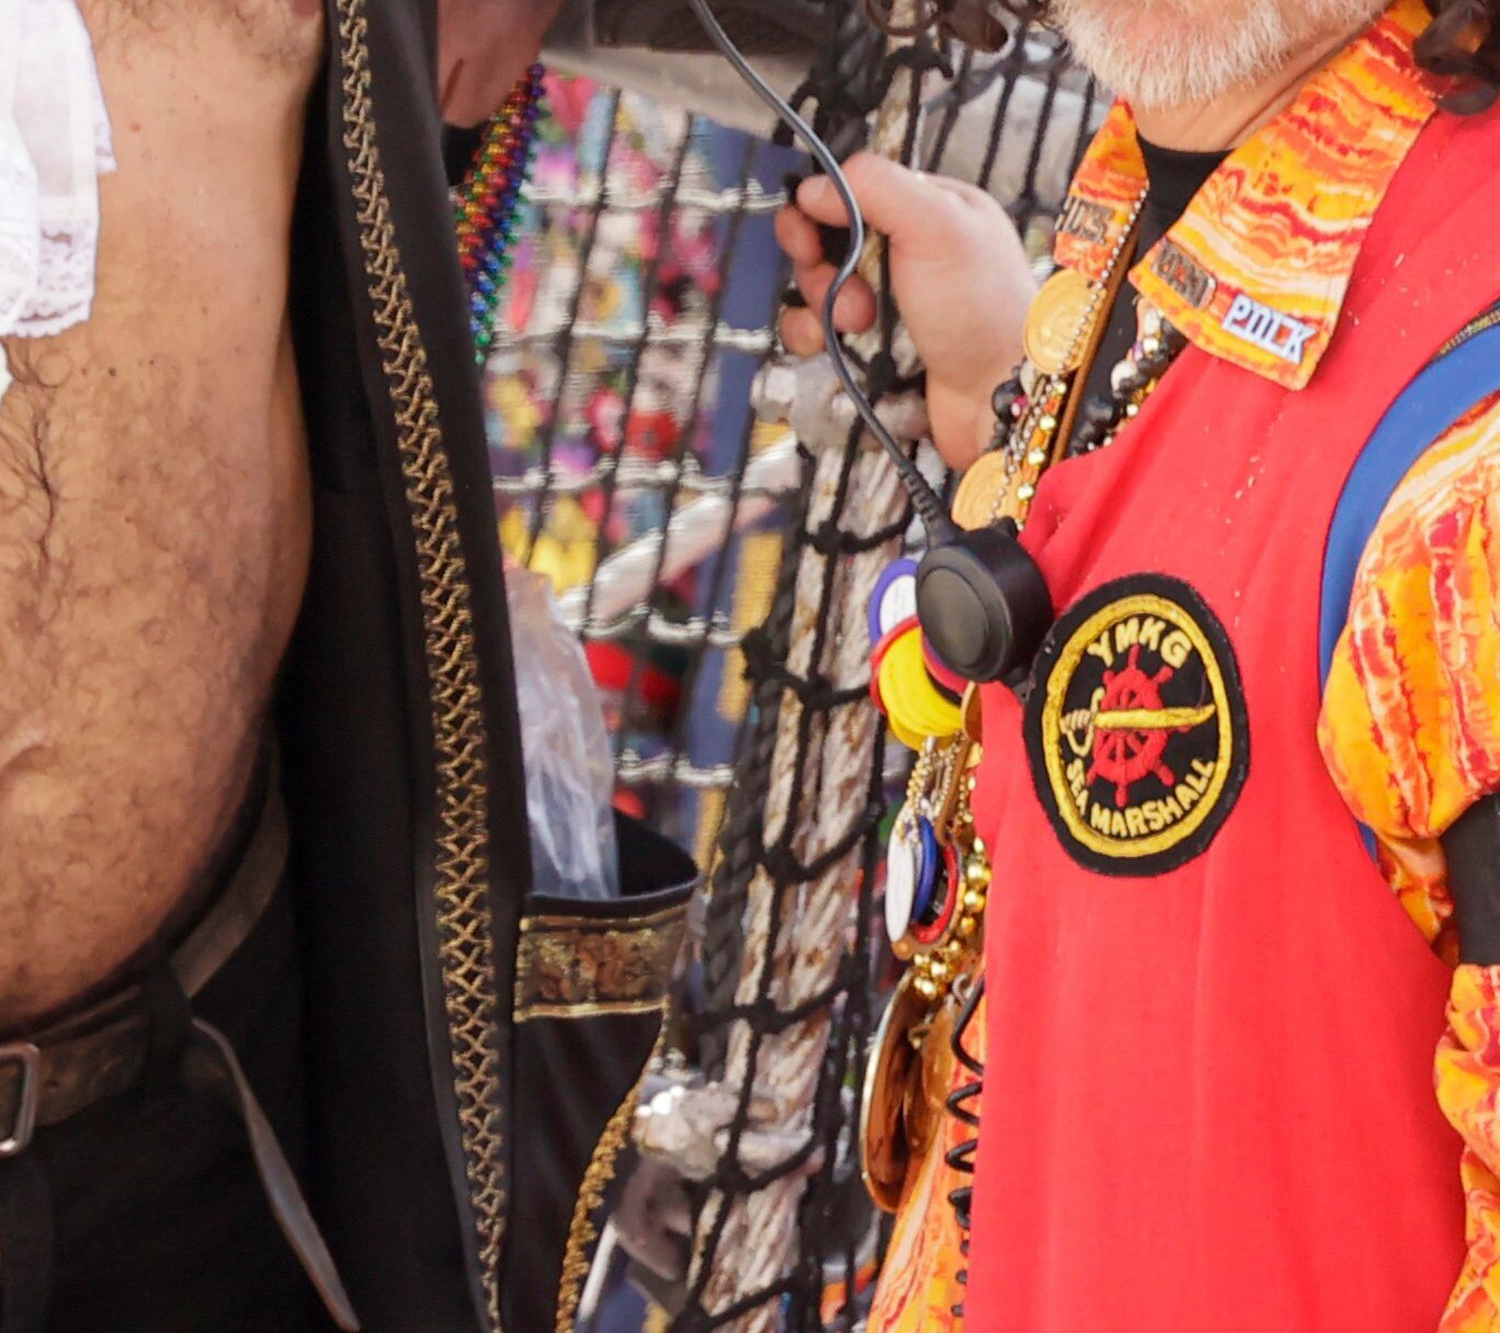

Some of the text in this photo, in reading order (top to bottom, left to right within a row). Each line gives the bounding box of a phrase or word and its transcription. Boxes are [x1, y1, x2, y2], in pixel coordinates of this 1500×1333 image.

[1087, 617, 1193, 669] YMKG
[1066, 758, 1216, 838] SEA MARSHALL
